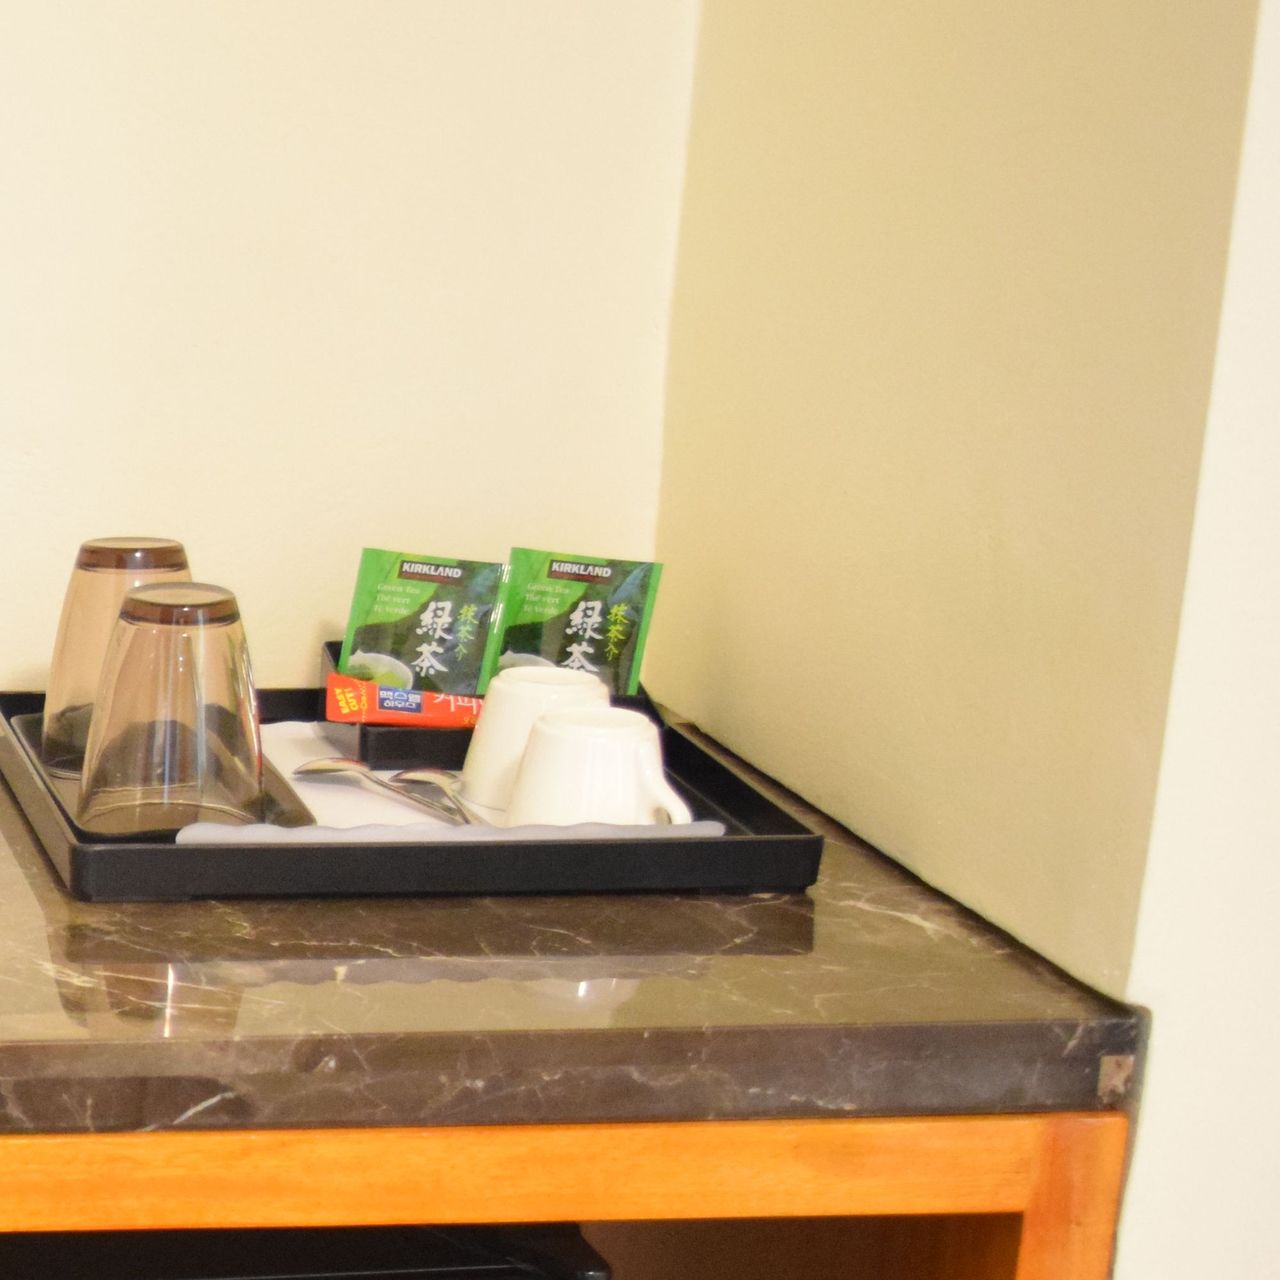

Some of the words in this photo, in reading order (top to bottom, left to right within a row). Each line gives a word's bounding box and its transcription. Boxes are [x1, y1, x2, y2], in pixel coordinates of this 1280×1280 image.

[402, 562, 462, 578] KIRKLAND
[551, 561, 612, 577] KIRKLAND
[410, 600, 454, 678] 緑茶
[334, 687, 351, 715] EASY
[433, 692, 484, 715] 커피
